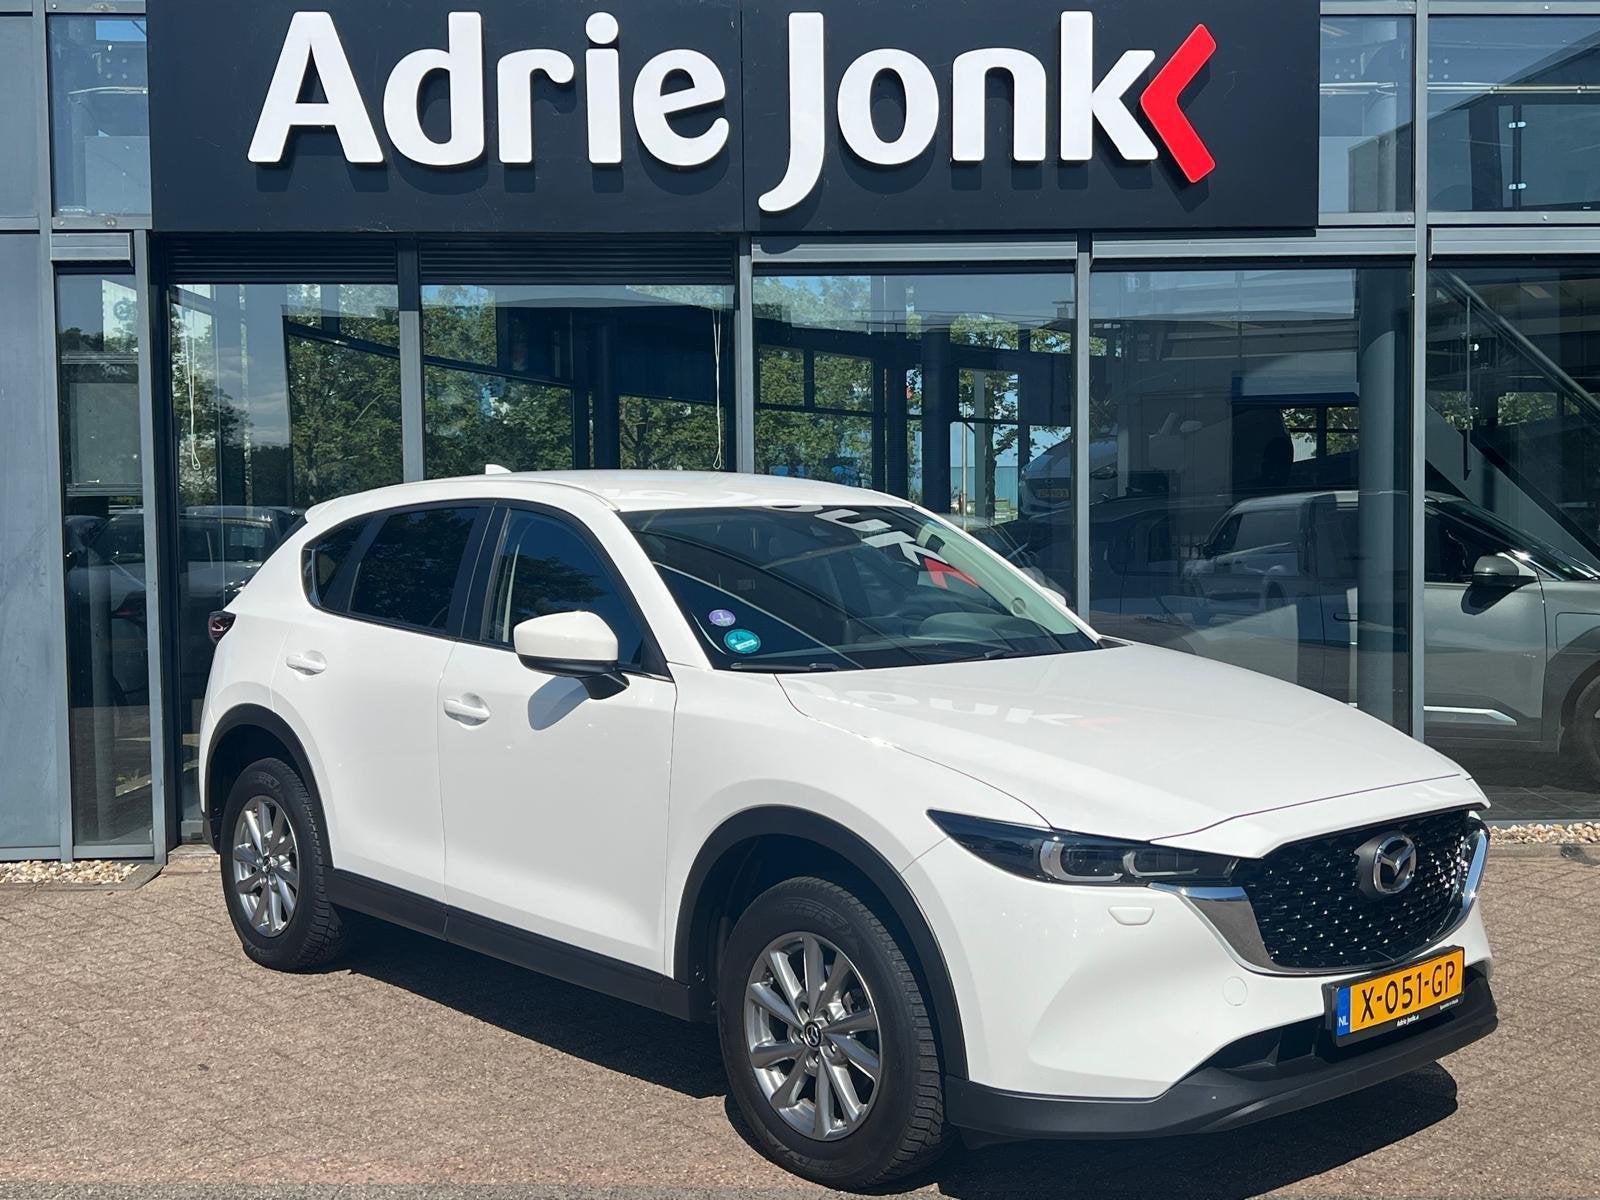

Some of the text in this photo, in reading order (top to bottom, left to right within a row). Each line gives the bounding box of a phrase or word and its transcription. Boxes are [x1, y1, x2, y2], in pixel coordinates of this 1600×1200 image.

[247, 10, 1159, 213] Adrie Jonk
[1338, 1016, 1349, 1027] NL
[1361, 961, 1456, 1023] X-051-GP
